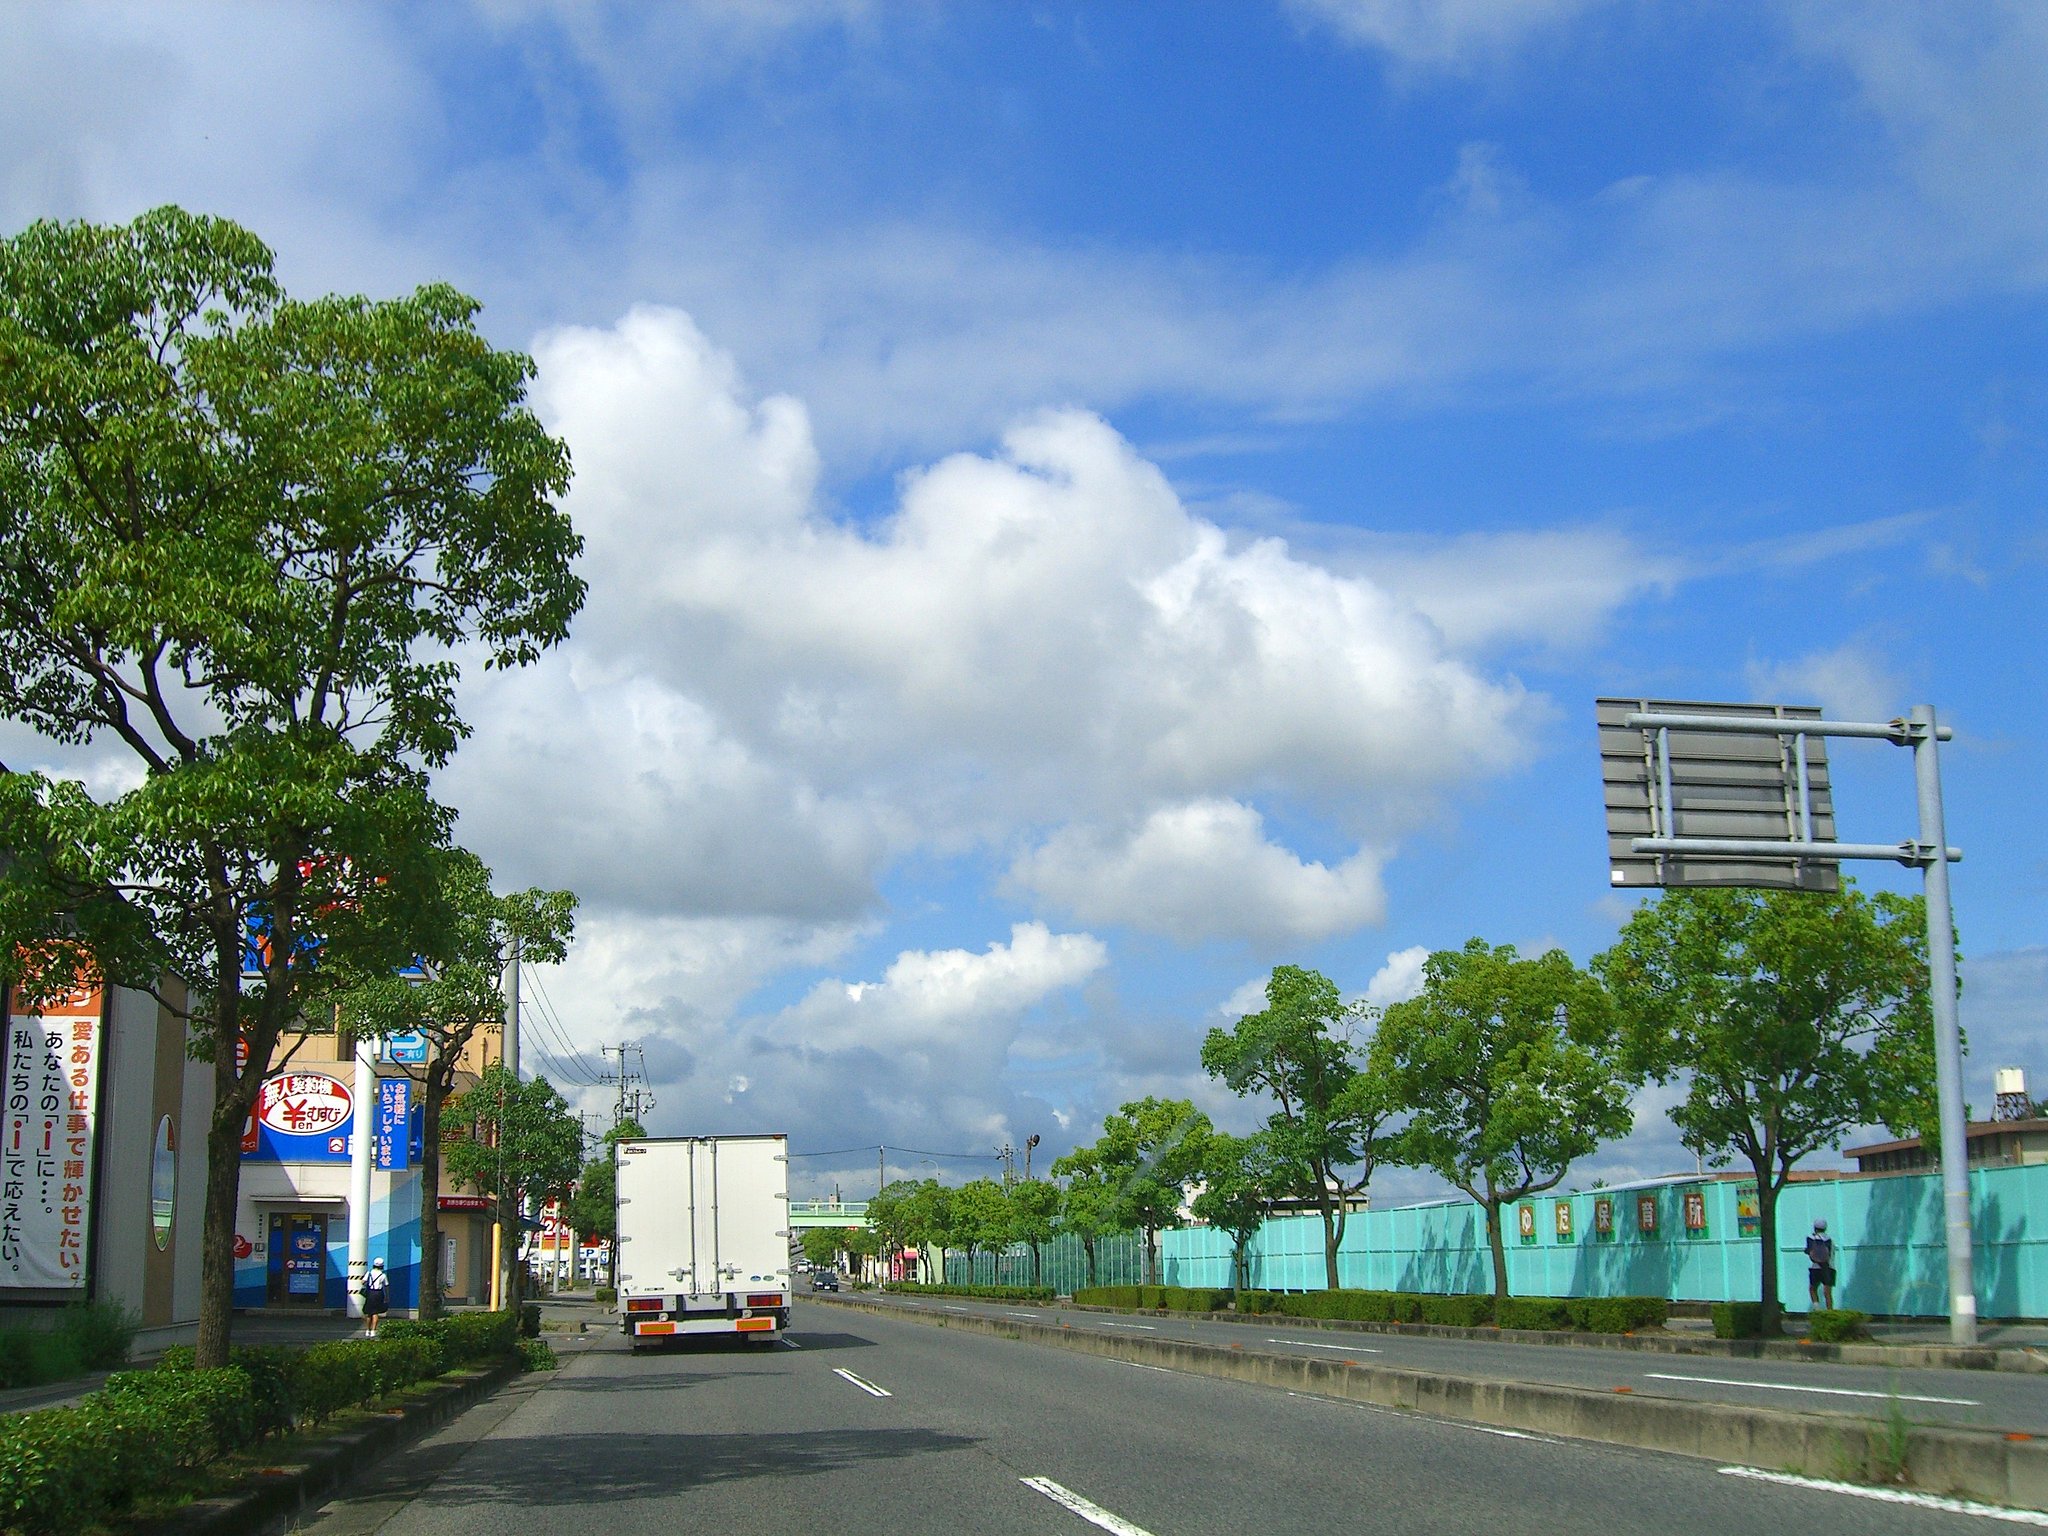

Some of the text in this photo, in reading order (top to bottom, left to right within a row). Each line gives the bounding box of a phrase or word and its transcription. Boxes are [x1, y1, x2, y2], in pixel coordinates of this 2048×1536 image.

[407, 1050, 423, 1059] 有り
[264, 1076, 334, 1110] 無人契約機
[394, 1082, 406, 1125] お気軽に
[380, 1083, 394, 1166] いらっしゃいませ
[60, 1021, 92, 1280] 愛ある仕事で輝かせたい。
